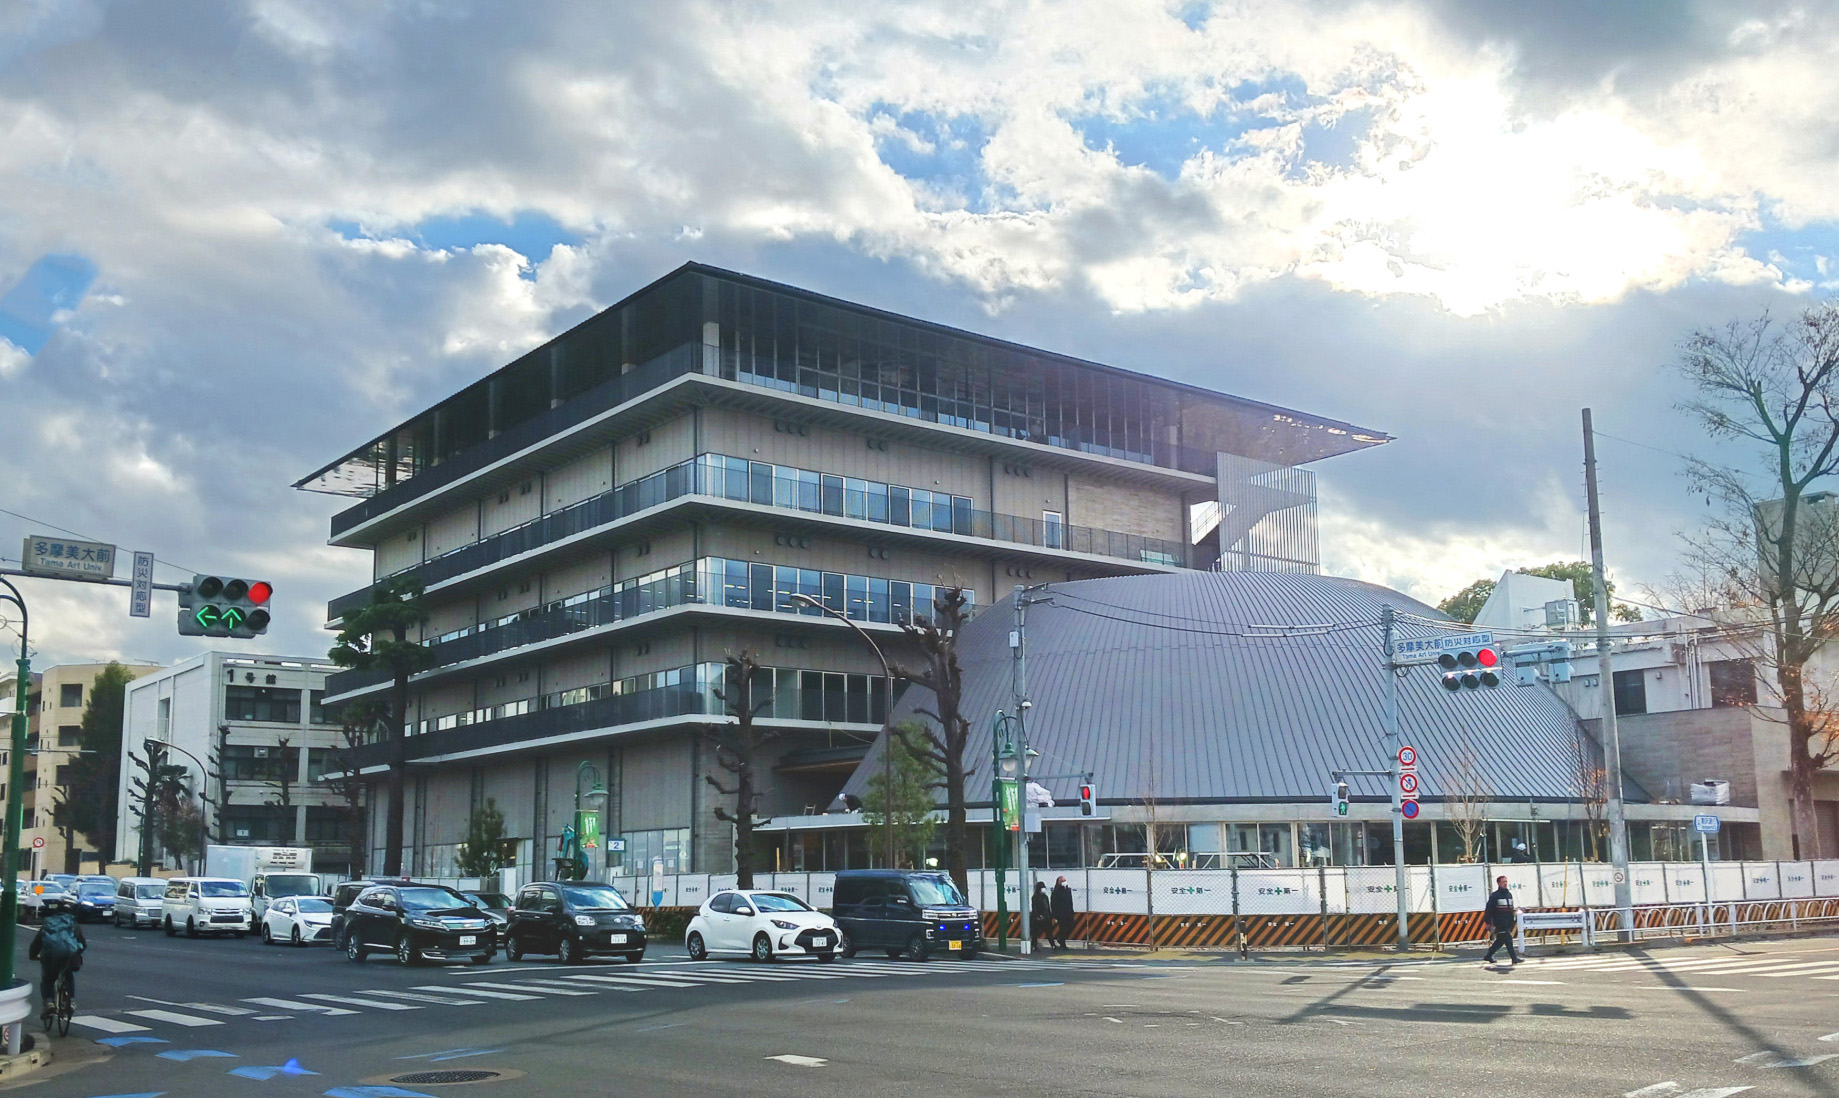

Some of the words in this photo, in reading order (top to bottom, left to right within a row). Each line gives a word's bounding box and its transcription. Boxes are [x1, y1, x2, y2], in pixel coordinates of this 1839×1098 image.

[34, 541, 111, 563] 多摩美大前
[40, 557, 64, 568] Tama
[67, 560, 81, 570] Art
[83, 561, 104, 572] Univ.
[135, 555, 149, 614] 防災対応型
[1397, 639, 1443, 654] 多摩美大前
[1444, 634, 1490, 647] 防災対応型
[1402, 751, 1413, 761] 30
[613, 841, 620, 850] 2
